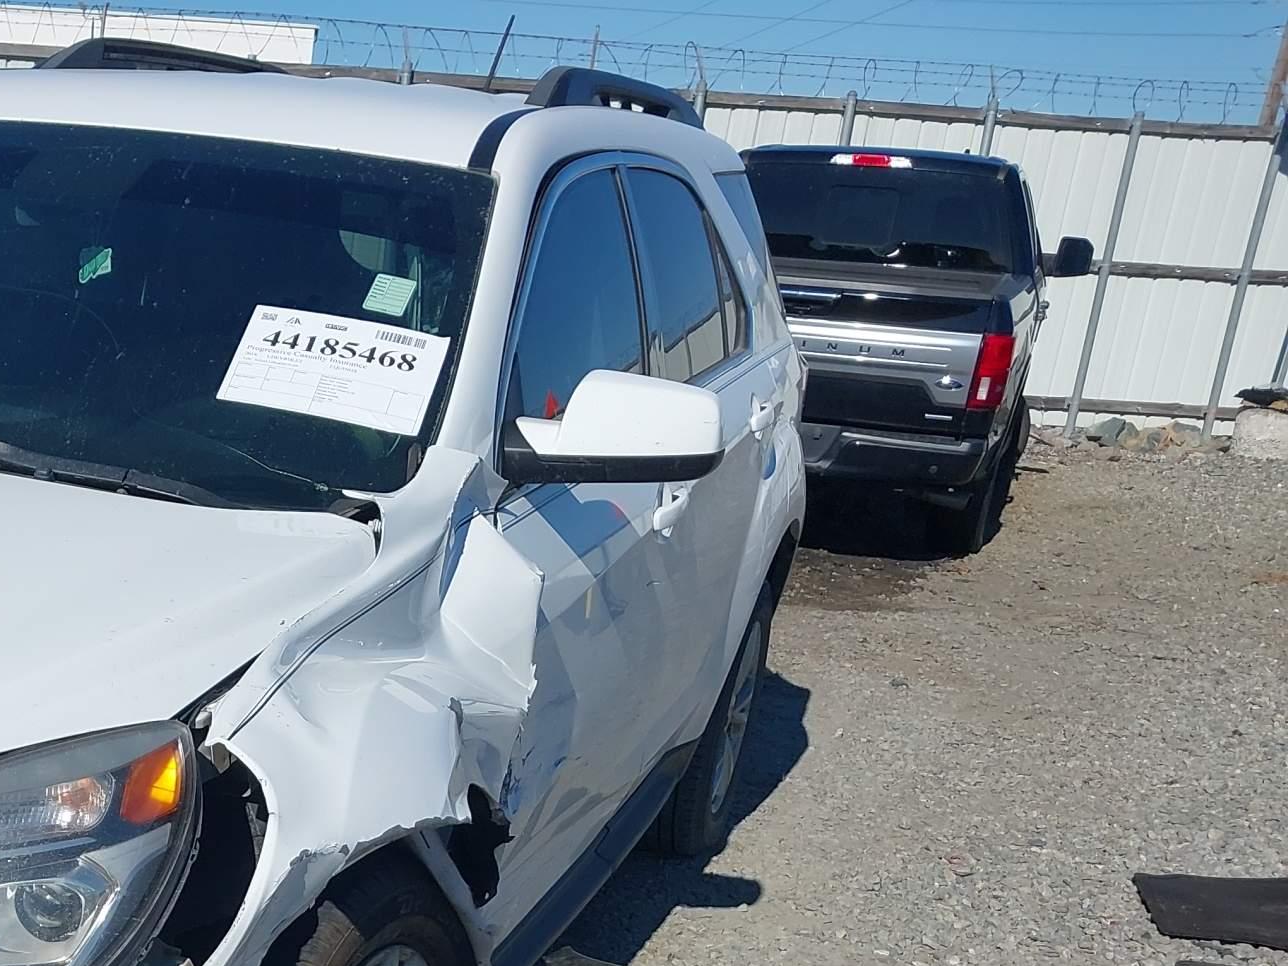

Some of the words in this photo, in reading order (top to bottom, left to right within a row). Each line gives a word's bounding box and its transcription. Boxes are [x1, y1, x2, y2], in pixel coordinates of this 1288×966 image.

[247, 344, 292, 356] Progressive
[293, 351, 328, 362] Casualty
[330, 357, 367, 369] Insurance
[262, 330, 417, 372] 44185468
[801, 340, 905, 357] INUM
